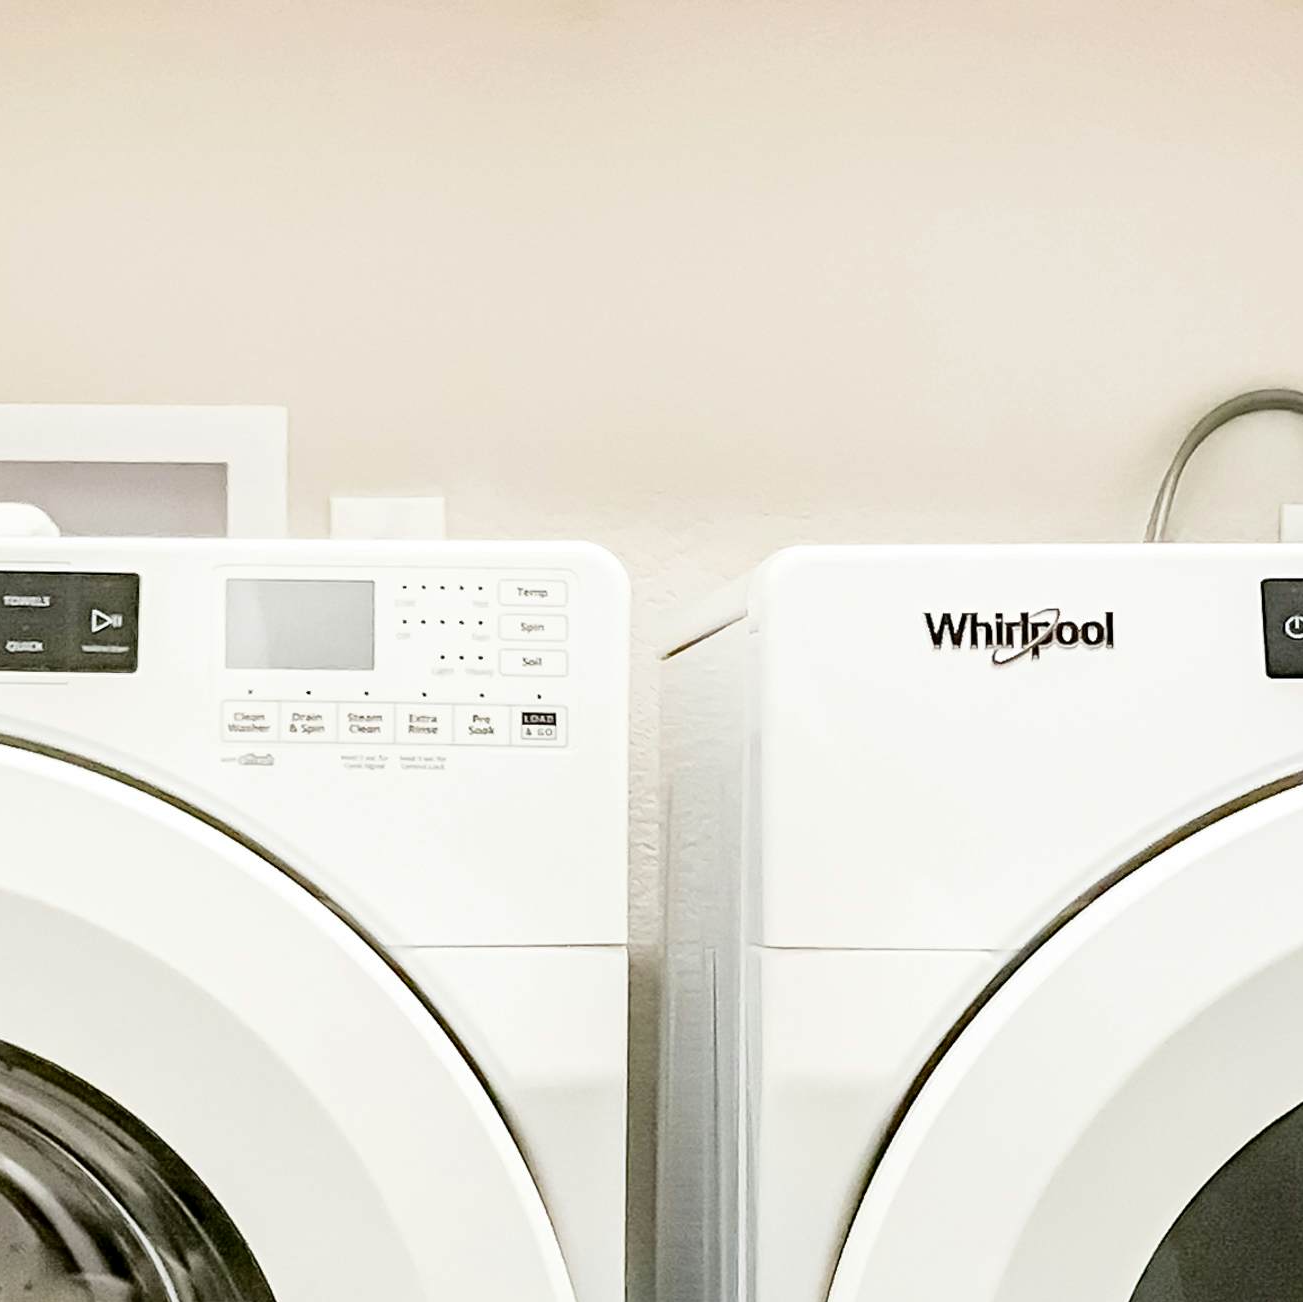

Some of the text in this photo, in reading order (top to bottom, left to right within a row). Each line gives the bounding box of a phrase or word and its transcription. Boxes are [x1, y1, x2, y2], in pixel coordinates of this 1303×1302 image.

[520, 623, 545, 632] Spin
[923, 608, 1114, 664] Whirlpool
[522, 657, 543, 666] Soil
[291, 713, 323, 721] Drain
[300, 724, 326, 734] Spin
[467, 726, 495, 735] Soak
